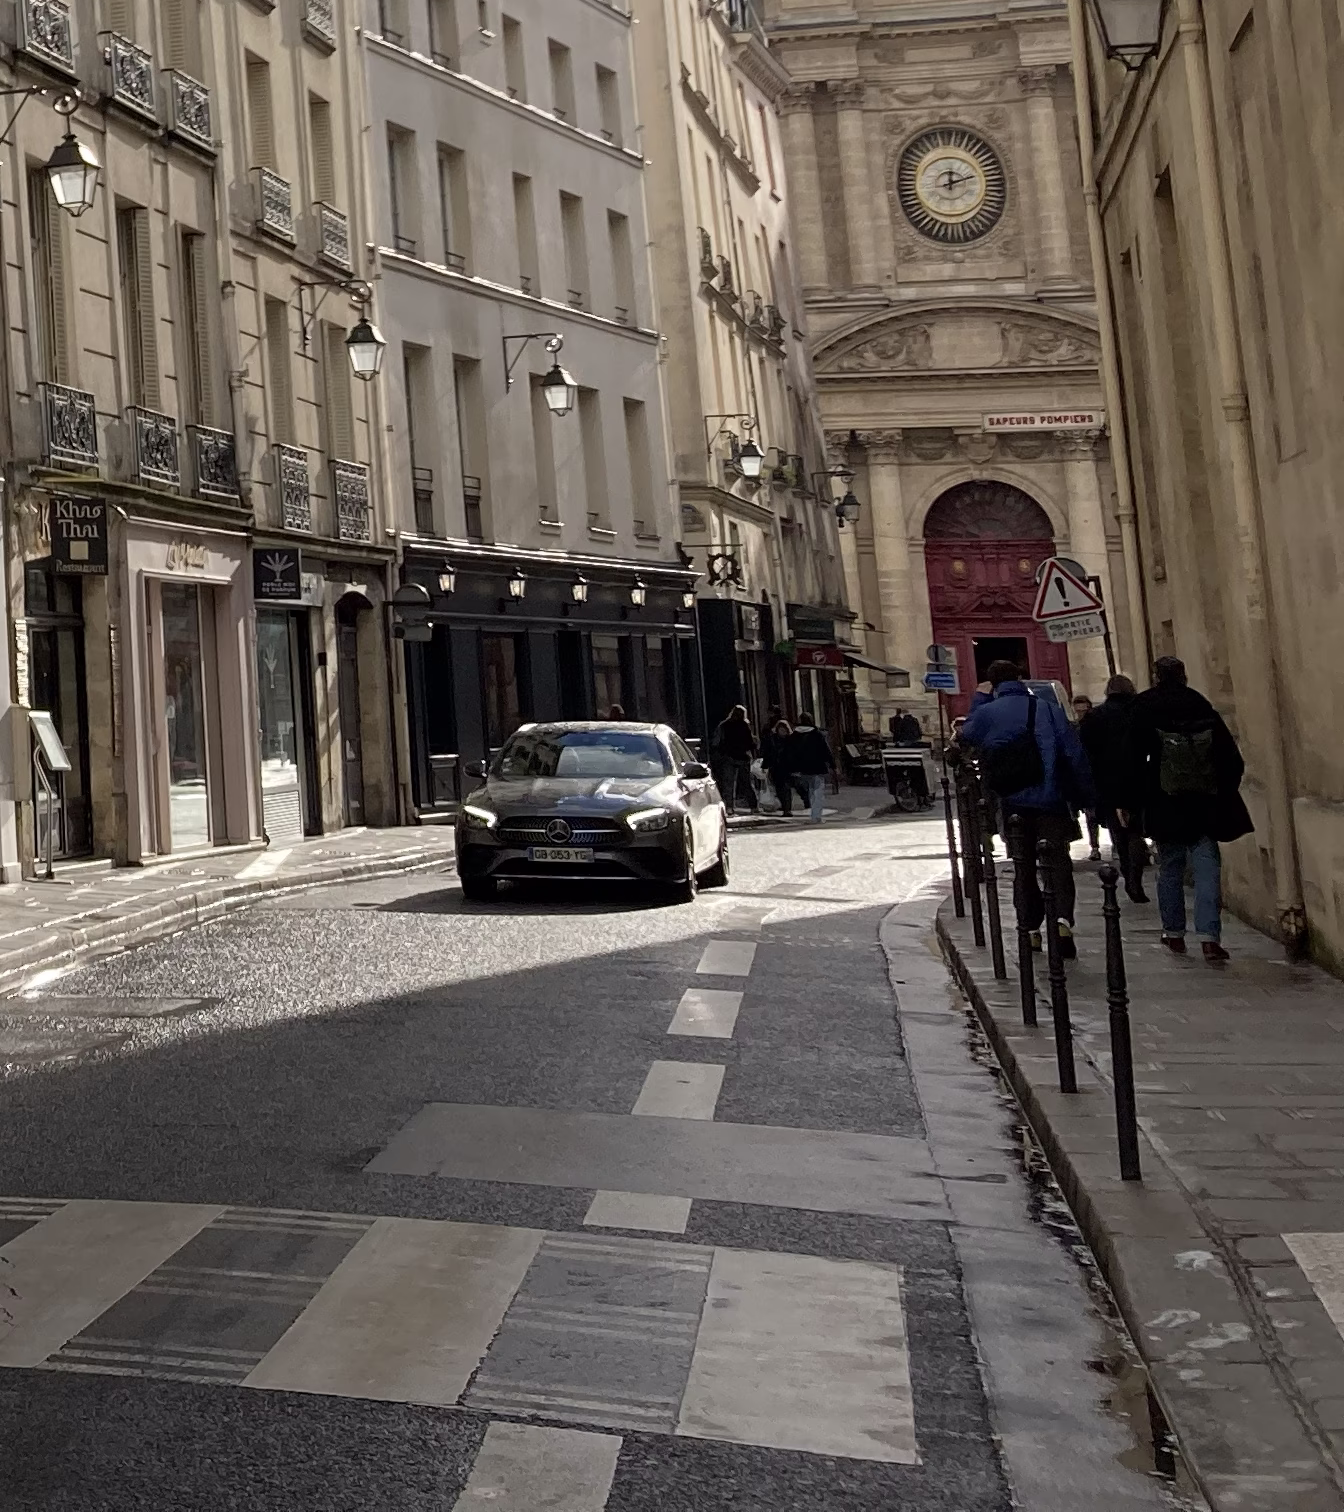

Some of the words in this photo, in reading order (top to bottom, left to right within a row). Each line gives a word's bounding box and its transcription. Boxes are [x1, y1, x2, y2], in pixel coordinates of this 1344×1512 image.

[988, 416, 1036, 426] SAPEURS
[1040, 414, 1094, 424] POMPIERS
[55, 500, 103, 518] Khao
[57, 519, 99, 538] Thai
[55, 559, 105, 573] Restaurant
